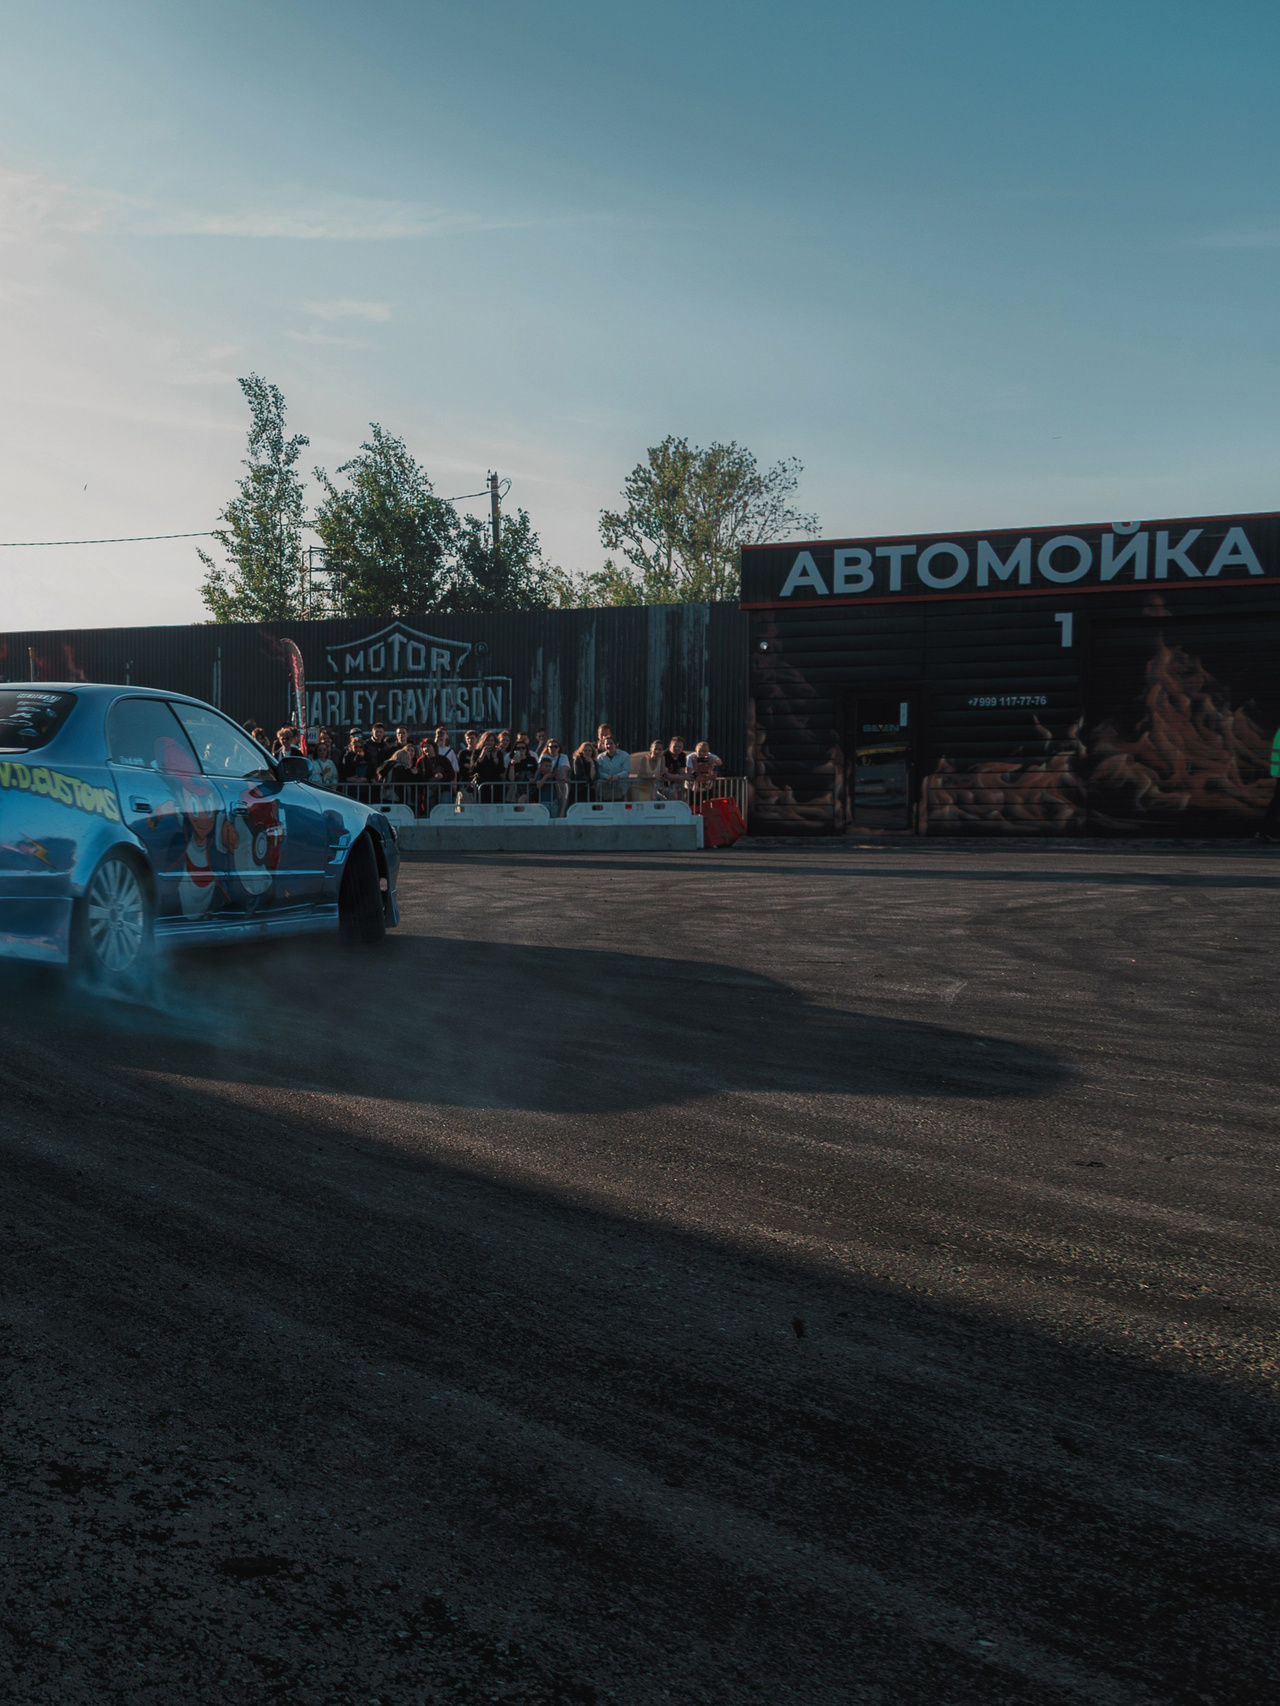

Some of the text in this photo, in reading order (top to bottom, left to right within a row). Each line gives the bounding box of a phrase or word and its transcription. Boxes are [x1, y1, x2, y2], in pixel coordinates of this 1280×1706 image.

[779, 522, 1265, 597] АВТОМОЙКА
[1054, 612, 1073, 648] 1
[345, 632, 450, 673] MOTOR
